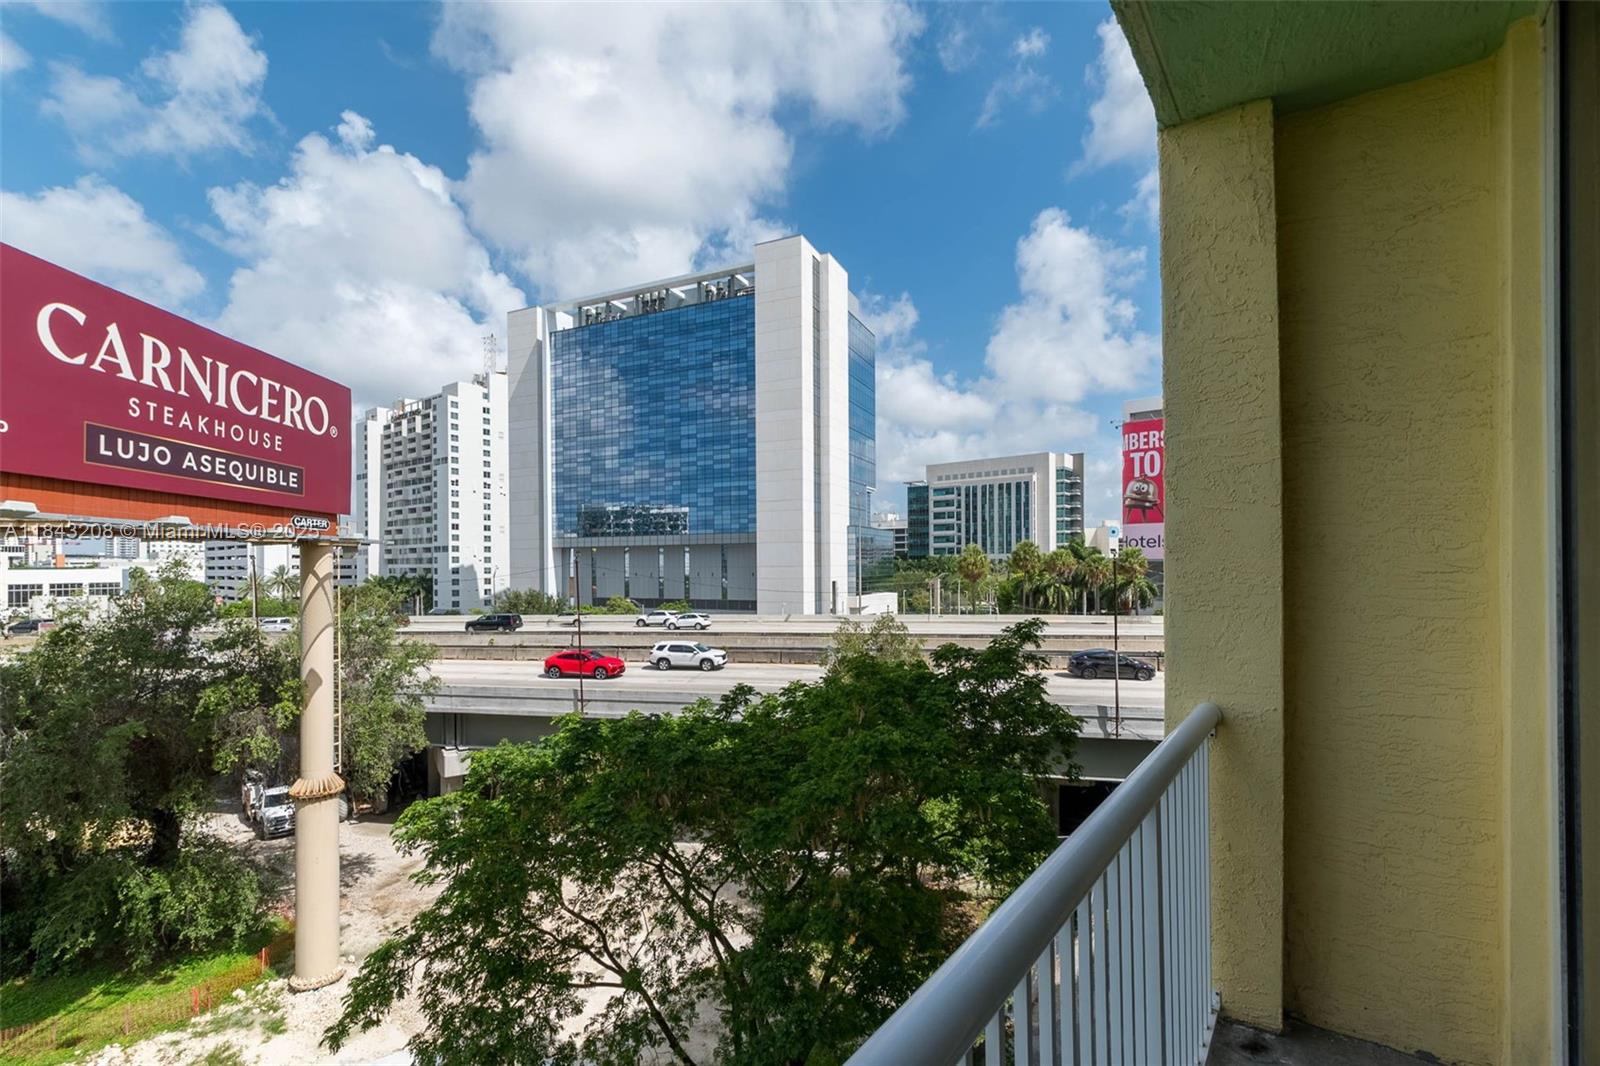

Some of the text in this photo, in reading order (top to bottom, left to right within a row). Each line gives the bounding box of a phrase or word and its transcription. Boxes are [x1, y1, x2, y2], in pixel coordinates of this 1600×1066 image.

[128, 397, 283, 452] STEAKHOUSE
[1124, 430, 1164, 451] BER
[99, 434, 299, 489] LUJO ASEQUIBLE
[1130, 450, 1161, 478] TO
[294, 517, 328, 528] CARTER
